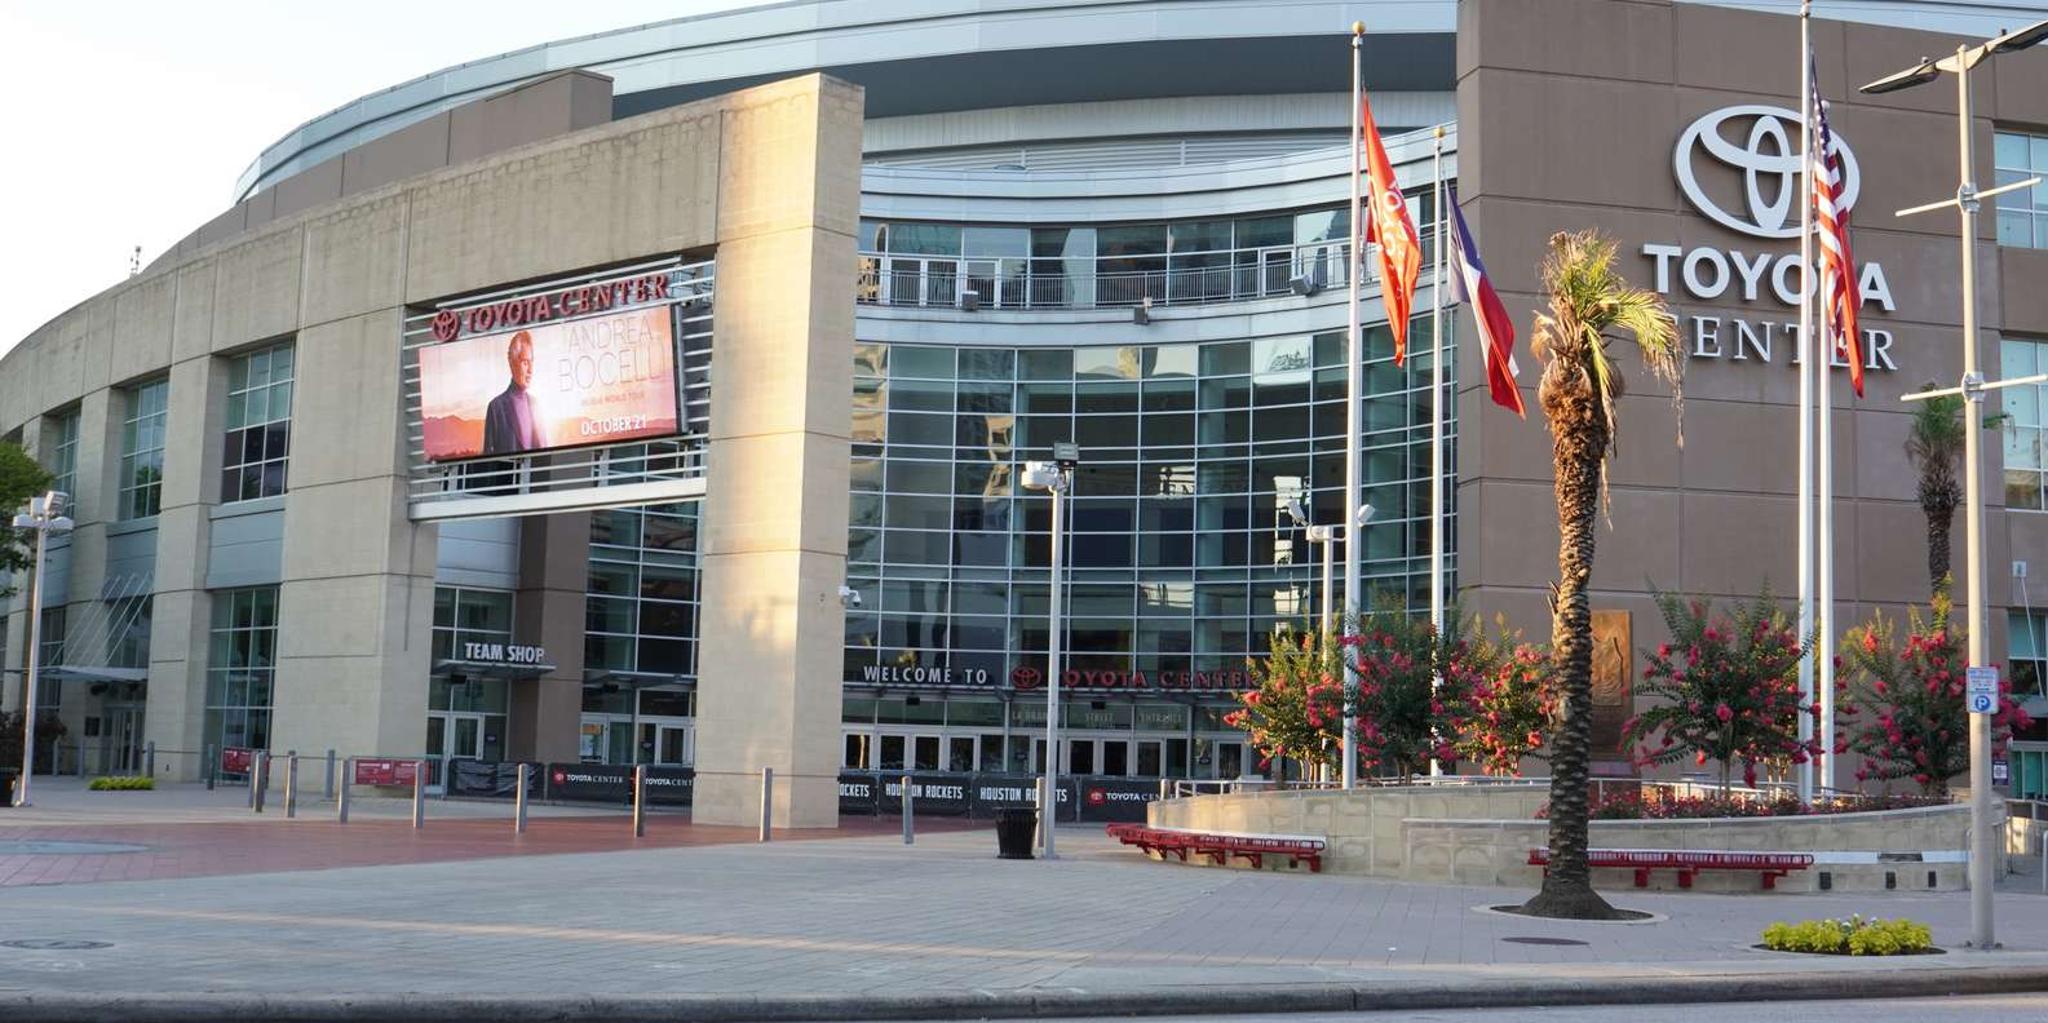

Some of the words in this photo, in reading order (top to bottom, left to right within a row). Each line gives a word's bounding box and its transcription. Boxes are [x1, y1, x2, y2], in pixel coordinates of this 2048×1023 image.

[1643, 244, 1896, 311] TOYOA
[466, 295, 552, 333] TOYOTA
[559, 273, 669, 317] CENTER
[567, 315, 652, 352] ANDREA
[1664, 312, 1898, 371] ENTR
[580, 415, 632, 436] OCTOBER
[634, 413, 647, 430] 21
[465, 642, 503, 661] TEAM
[507, 644, 545, 663] SHOP
[864, 665, 952, 683] WELCOME
[965, 668, 987, 684] TO
[1062, 669, 1149, 688] OYOTA
[566, 774, 592, 782] TOYOTA
[645, 778, 671, 786] TOYOTA
[885, 783, 922, 798] HOUON
[925, 785, 963, 800] ROCKETS
[980, 787, 1022, 801] HOUSTON
[1025, 788, 1068, 803] ROTS
[1105, 792, 1141, 800] TOYOTA
